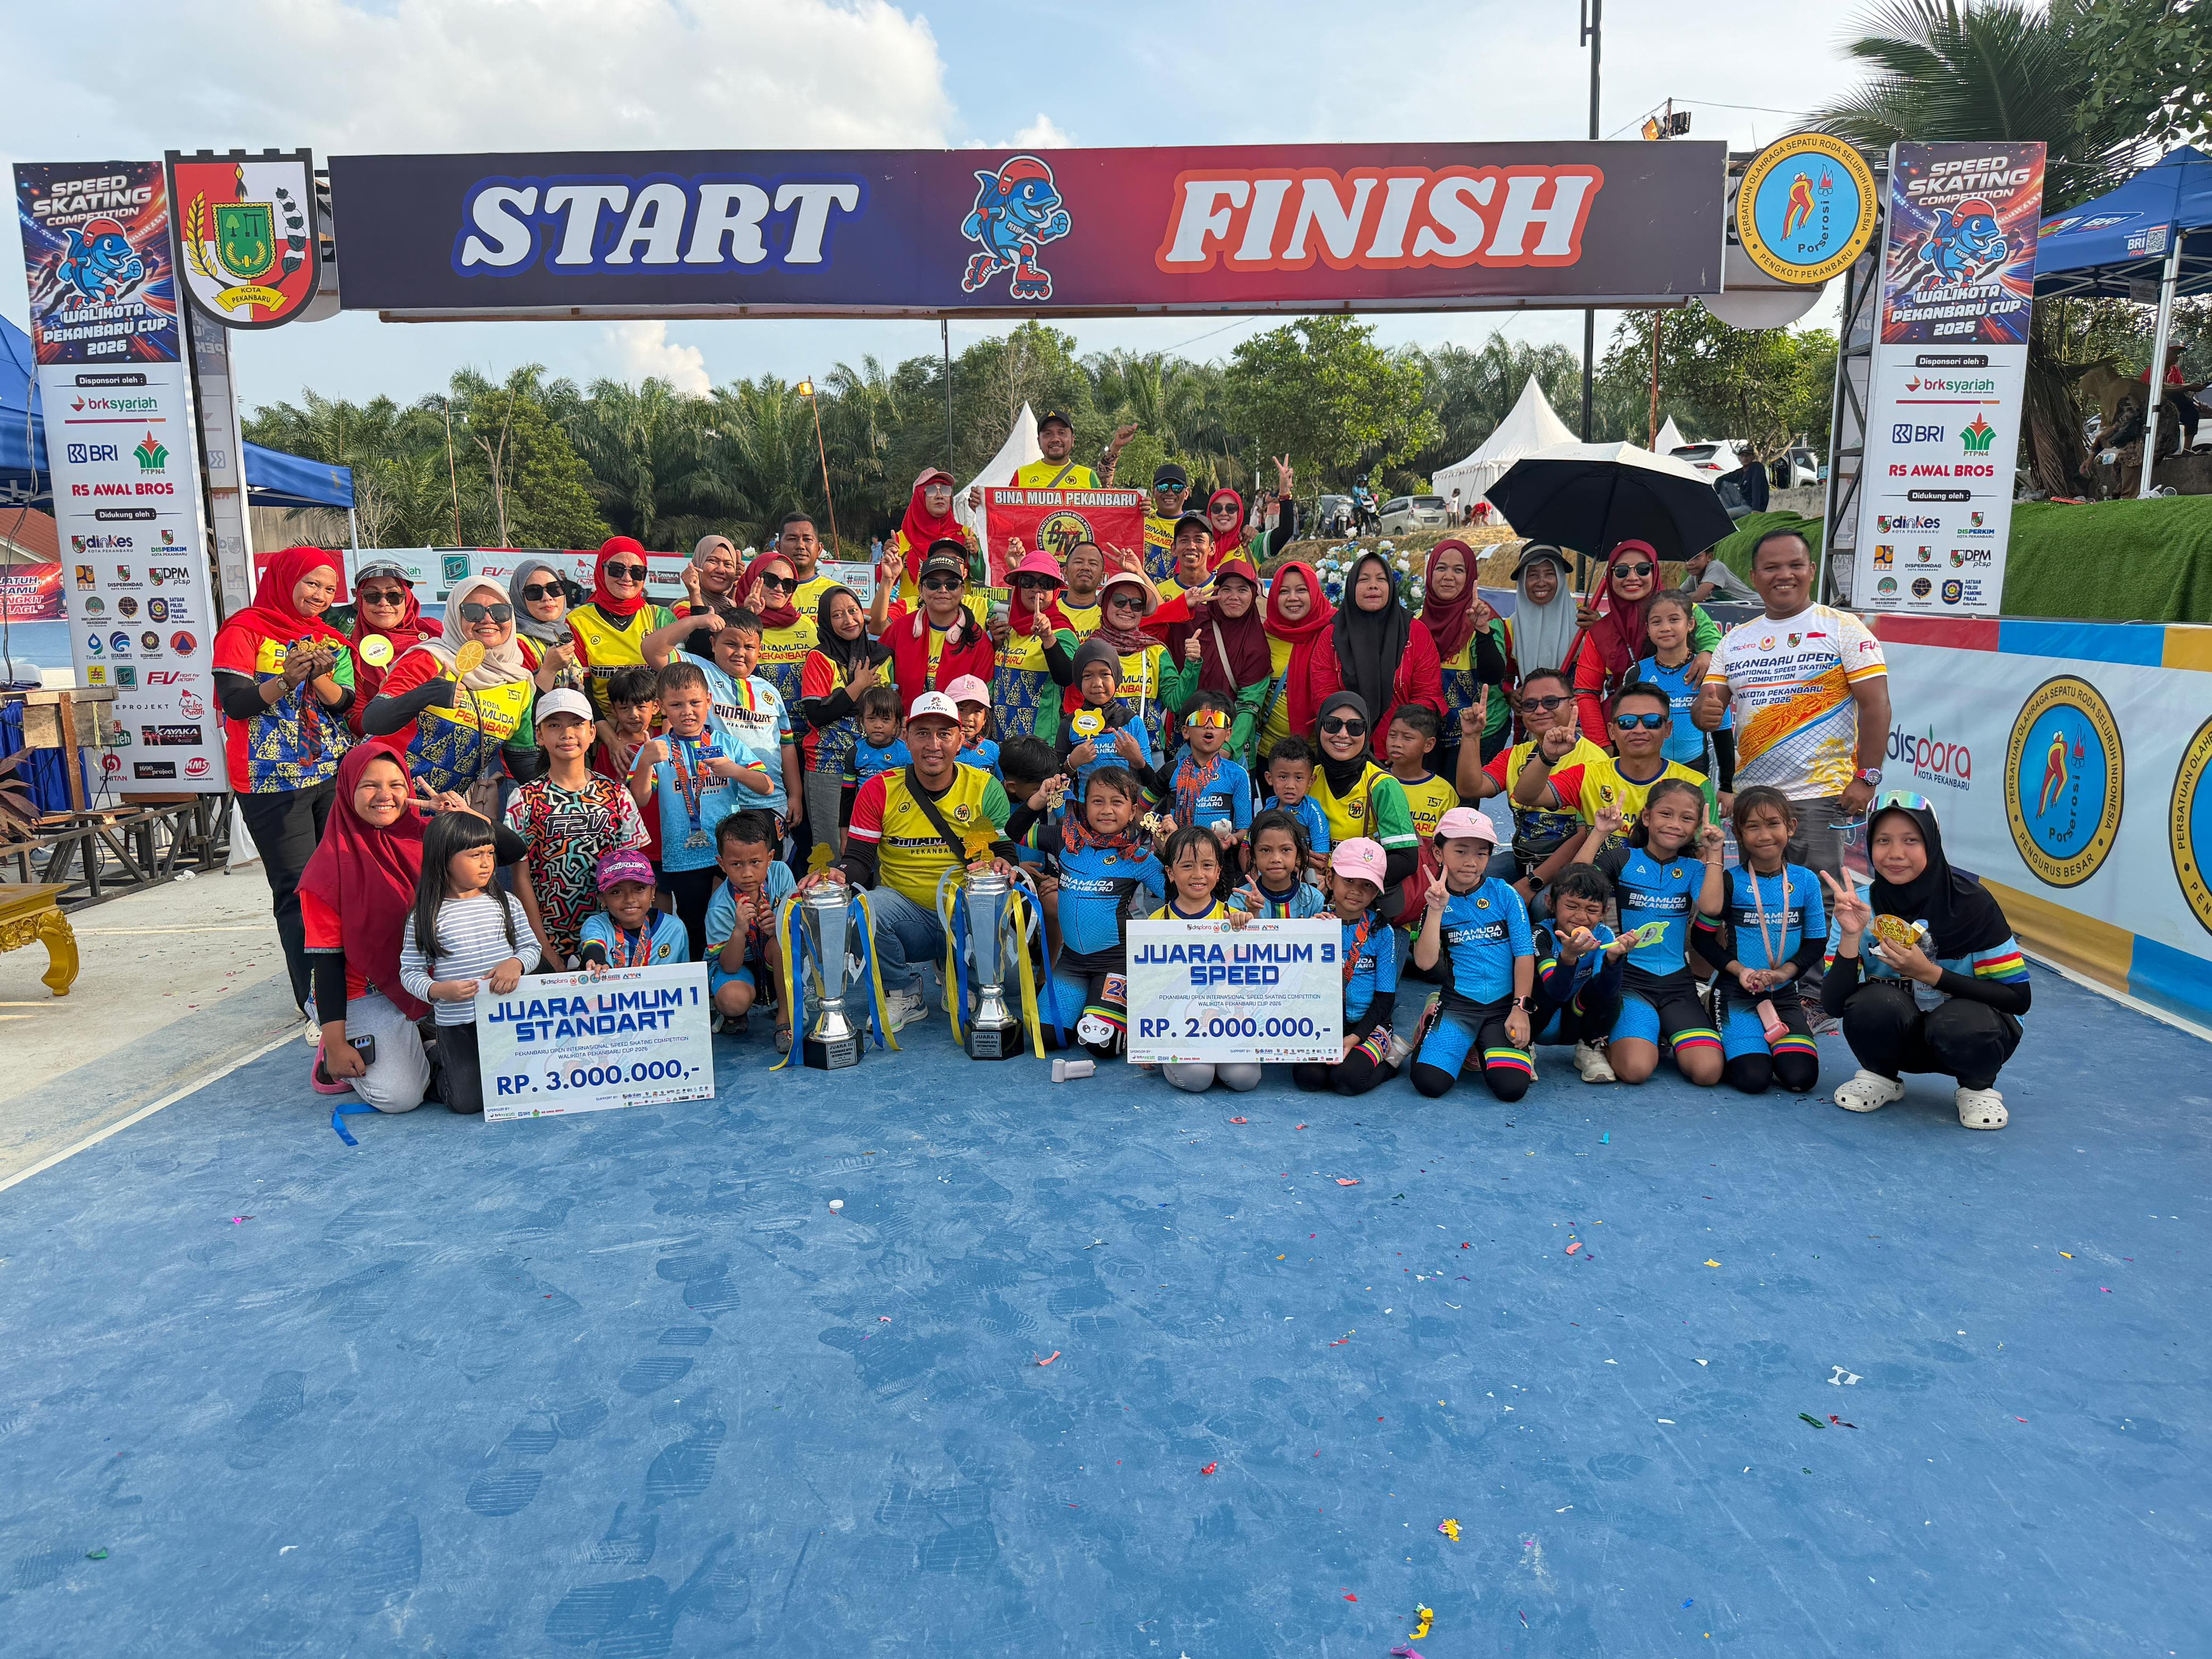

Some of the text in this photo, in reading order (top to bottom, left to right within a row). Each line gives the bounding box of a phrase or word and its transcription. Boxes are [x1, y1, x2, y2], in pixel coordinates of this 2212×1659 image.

[1930, 157, 2008, 177] SPEED
[51, 175, 127, 198] SPEED
[1742, 138, 1872, 237] PERSATUAN OLAHRAGA SEPATU RODA SELURUH INDONESIA
[1906, 168, 2030, 196] SKATING
[32, 187, 152, 217] SKATING
[1918, 188, 2014, 206] COMPETITION
[46, 207, 139, 227] COMPETITION
[460, 183, 860, 267] START
[1165, 175, 1594, 262] FINISH
[1798, 200, 1830, 253] Porserosi
[2127, 237, 2146, 250] BRI
[1759, 249, 1853, 278] PENGKOT PEKANBARU
[231, 295, 271, 305] PEKANBARU
[1913, 284, 2000, 304] WALIKOTA
[62, 303, 144, 323] WALIKOTA
[1891, 300, 2021, 323] PEKANBARU CUP
[43, 319, 167, 343] PEKANBARU CUP
[1933, 321, 1976, 336] 2026
[87, 340, 127, 356] 2026
[1920, 357, 1960, 366] Disponsori
[1924, 379, 1994, 393] brksyariah
[88, 397, 158, 412] brksyariah
[1914, 426, 1945, 442] BRI
[89, 445, 118, 461] BRI
[1889, 465, 1994, 477] RS AWAL BROS
[72, 482, 174, 496] RS AWAL BROS
[1912, 492, 1946, 500] Didukung
[994, 491, 1138, 506] BINA MUDA PEKANBARU
[1892, 515, 1940, 529] dinkes
[86, 534, 133, 548] dinkes
[1965, 549, 1991, 561] DPM
[163, 567, 189, 579] DPM
[971, 587, 1008, 600] COMPETITION
[1724, 652, 1835, 674] PEKANBARU OPEN
[1773, 666, 1796, 675] SPEED
[1748, 673, 1796, 683] COMPETITION
[1767, 686, 1823, 697] PEKANBARU
[483, 700, 500, 710] RODA
[1887, 724, 1972, 782] dispora
[2009, 685, 2118, 831] PERSATUAN OLAHRAGA SEPATU RODA SELURUH INDONESIA
[1917, 769, 1970, 791] KOTA PEKANBARU
[2177, 773, 2194, 850] PERSATUAN
[2018, 831, 2095, 878] PENGURUS BESAR
[1059, 879, 1113, 892] PEKANBARU
[1060, 873, 1113, 887] BINAMUDA
[1629, 893, 1687, 904] BINAMUDA
[1629, 900, 1686, 909] PEKANBARU
[1448, 925, 1501, 939] BINAMUDA
[1449, 930, 1503, 943] PEKANBARU
[1883, 928, 1902, 938] COIN
[1134, 943, 1335, 963] JUARA UMUM 3
[1191, 966, 1279, 985] SPEED
[488, 987, 698, 1022] JUARA UMUM 1
[516, 1010, 675, 1043] STANDART
[1140, 1018, 1330, 1041] RP. 2.000.000,-
[566, 1043, 609, 1052] INTERNASIONAL
[1370, 1028, 1388, 1053] 28
[497, 1060, 700, 1095] RP. 3.000.000,-
